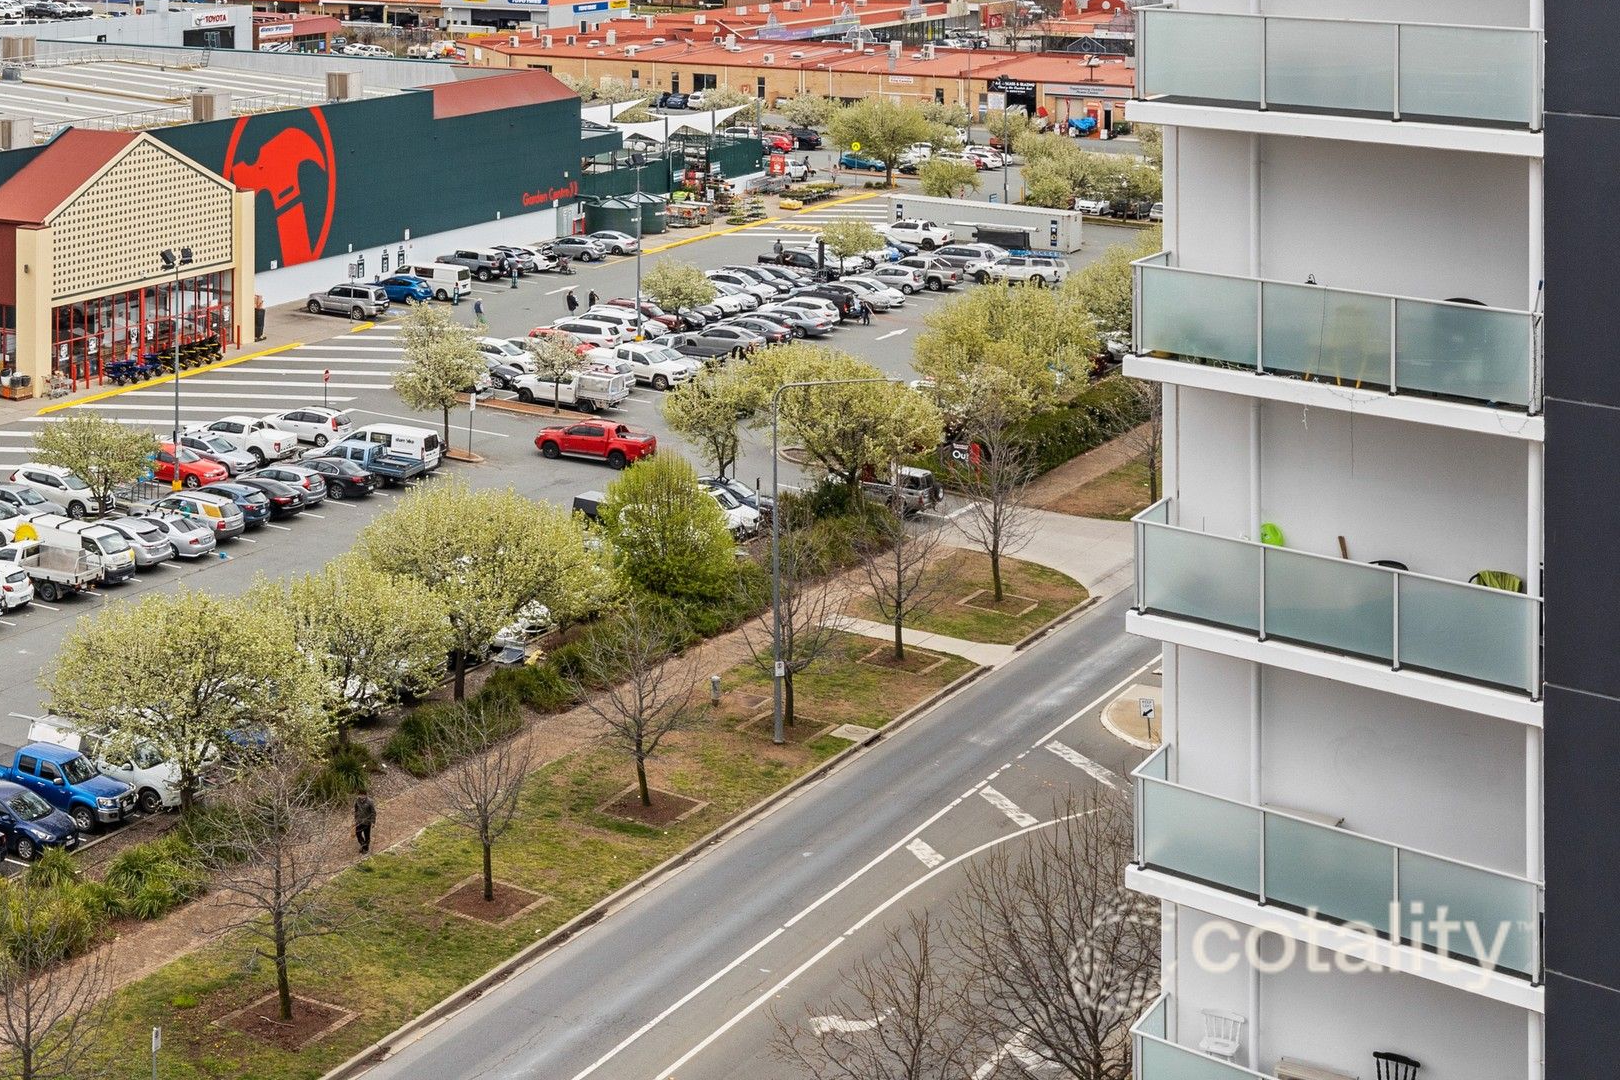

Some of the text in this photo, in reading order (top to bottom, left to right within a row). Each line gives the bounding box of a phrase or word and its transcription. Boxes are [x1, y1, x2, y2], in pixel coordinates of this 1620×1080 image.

[205, 14, 227, 24] TOYOTA
[522, 186, 572, 207] Garden Centre
